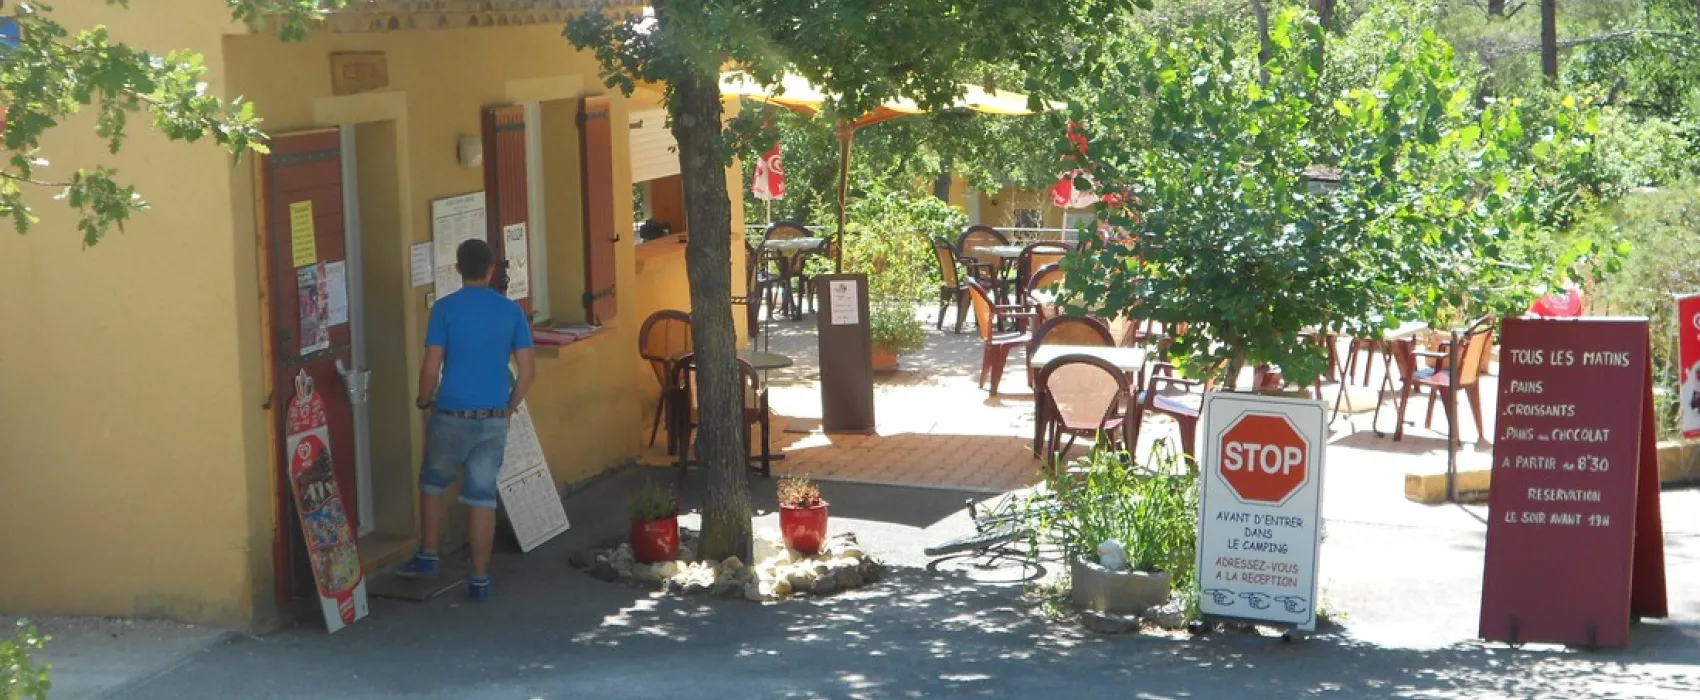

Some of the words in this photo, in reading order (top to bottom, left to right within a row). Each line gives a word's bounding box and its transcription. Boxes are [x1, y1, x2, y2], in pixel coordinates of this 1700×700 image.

[1510, 349, 1544, 365] TOUS
[1550, 350, 1574, 366] LES
[1583, 351, 1630, 367] MATINS
[1551, 428, 1610, 442] CHOCOLAT
[1224, 441, 1303, 475] STOP
[1502, 457, 1511, 468] A
[1515, 456, 1557, 470] PARTIR
[1527, 488, 1601, 502] RESERVATION
[1216, 511, 1250, 523] AVANT
[1254, 514, 1304, 528] D'ENTRER
[1504, 512, 1517, 524] LE
[1520, 512, 1546, 524] SOIR
[1550, 513, 1582, 525] AVANT
[1244, 527, 1273, 539] DANS
[1227, 538, 1239, 550] LE
[1242, 540, 1288, 554] CAMPING
[1215, 556, 1299, 575] ADRESSEZ-VOUS
[1215, 570, 1222, 580] A
[1225, 571, 1238, 581] LA
[1242, 572, 1298, 588] RECEPTION
